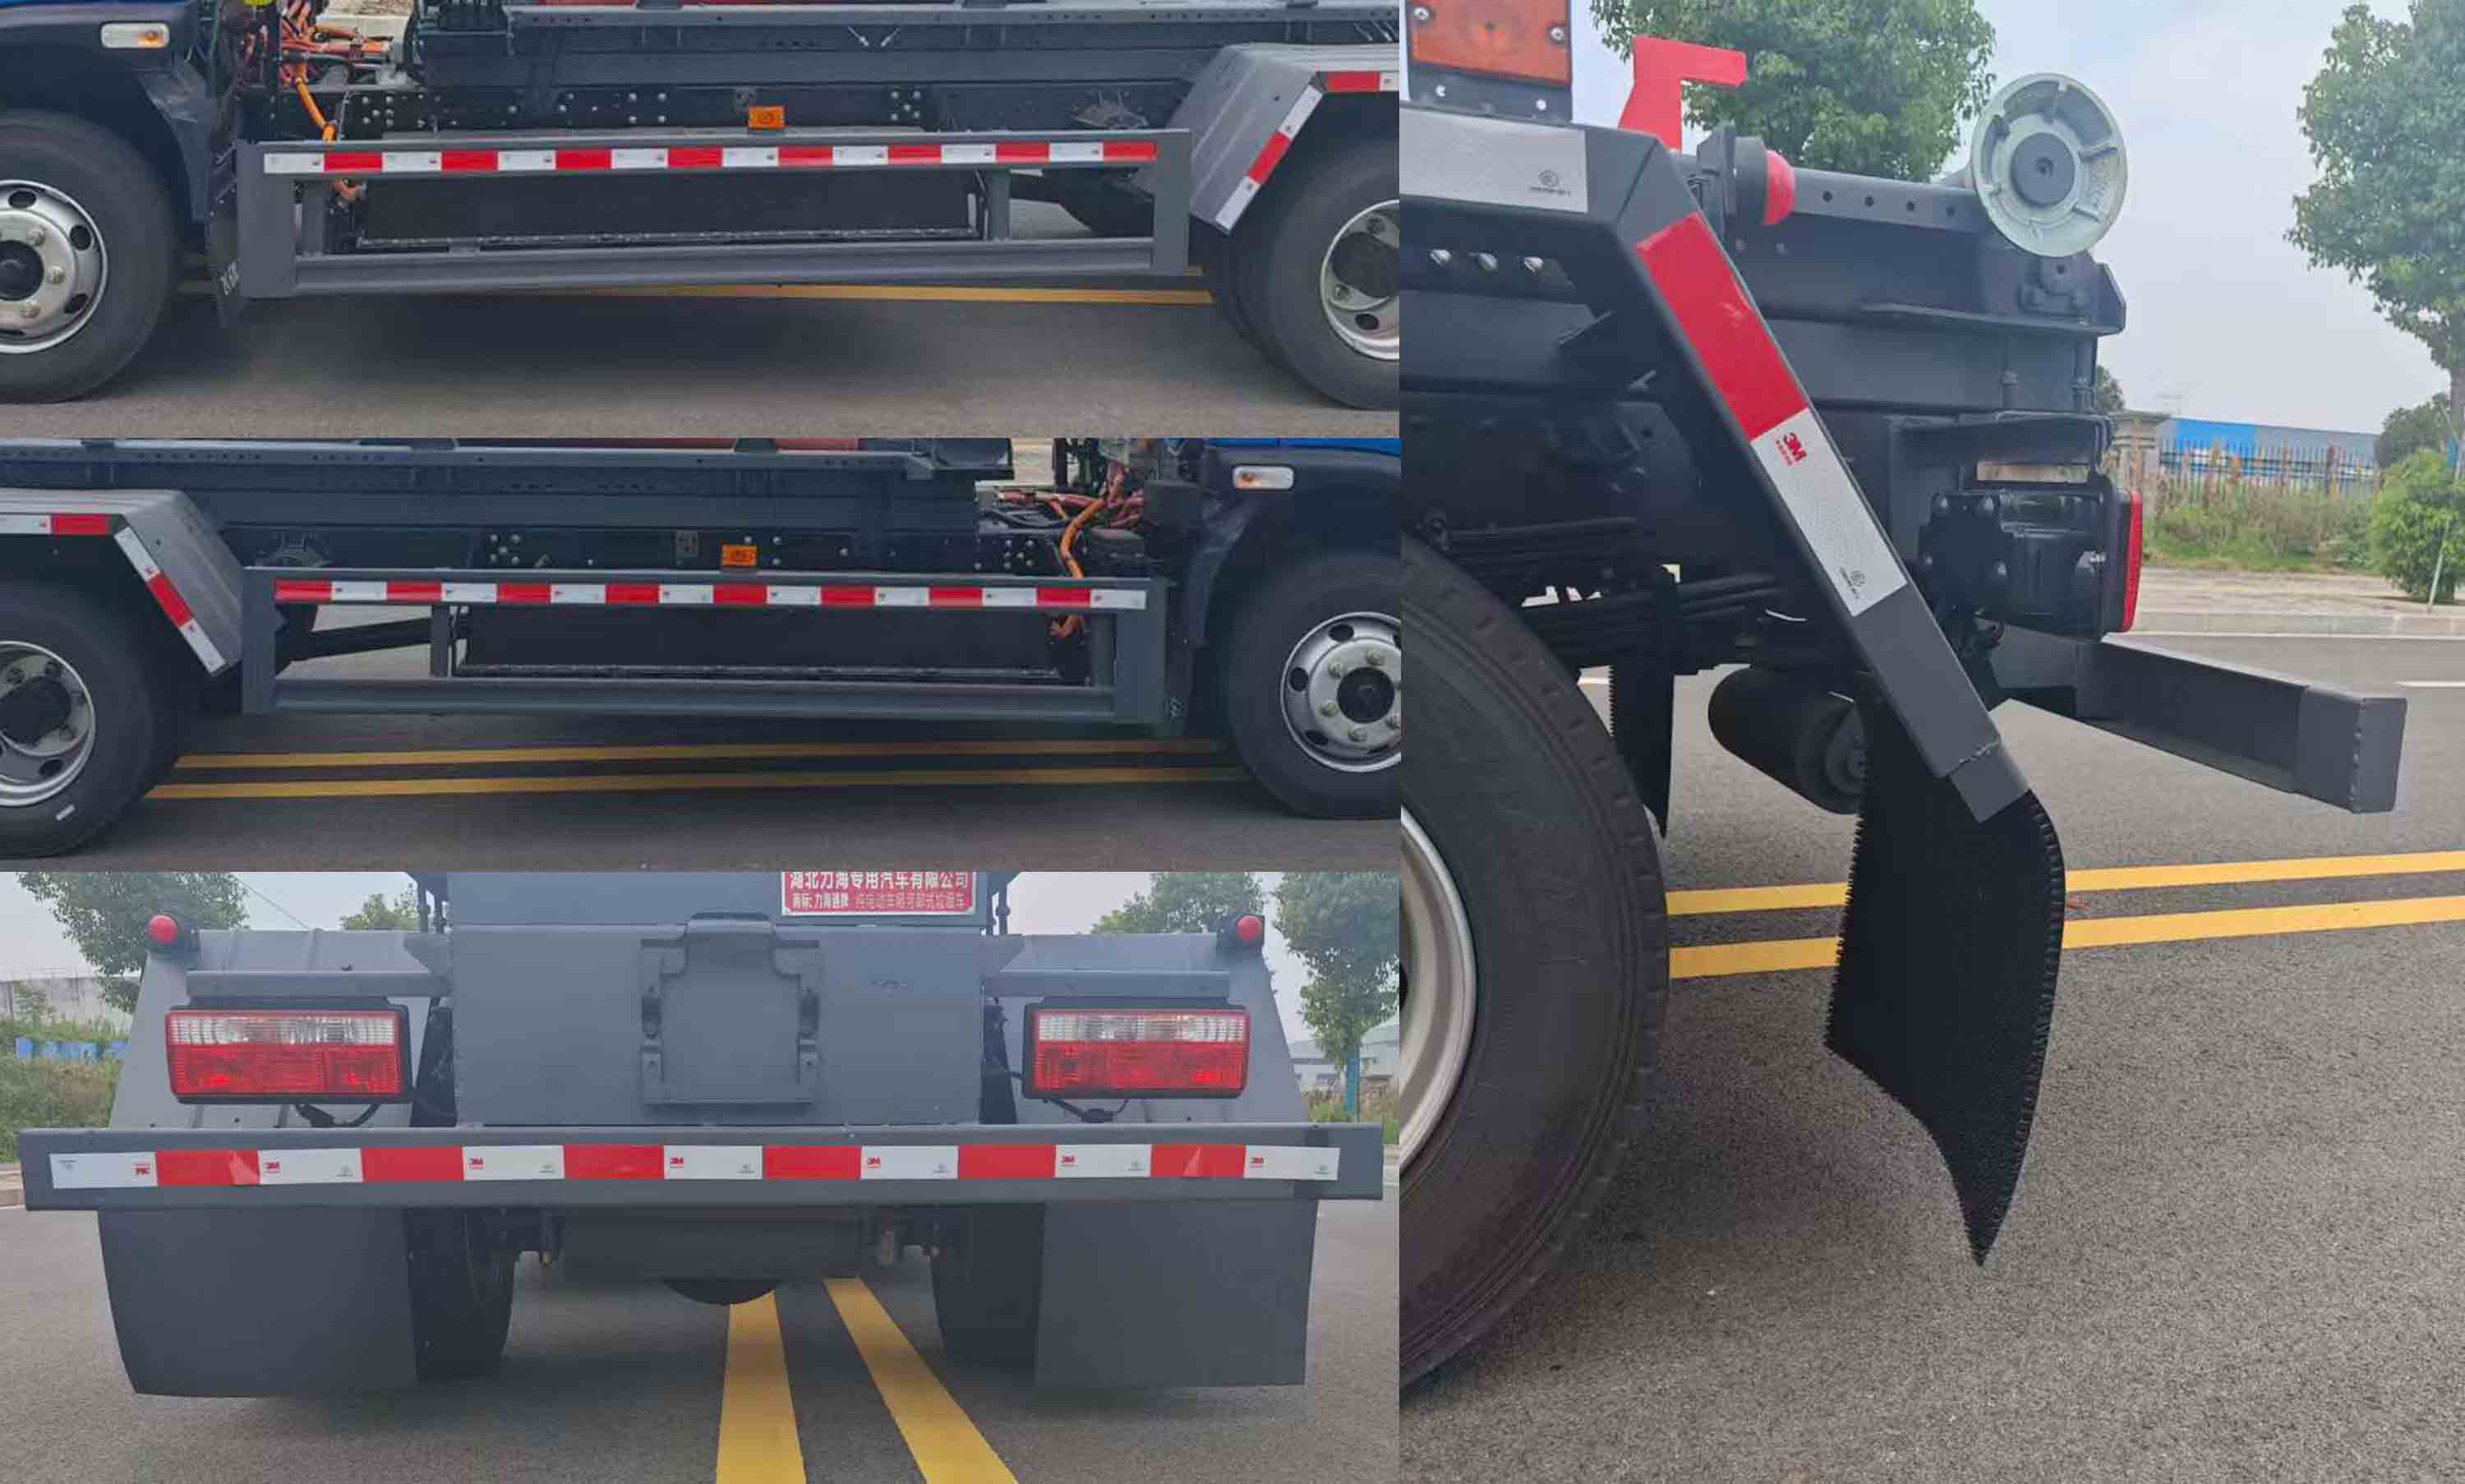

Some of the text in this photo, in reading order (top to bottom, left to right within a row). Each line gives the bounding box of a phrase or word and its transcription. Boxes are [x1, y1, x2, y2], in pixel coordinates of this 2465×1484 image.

[1783, 432, 1807, 462] 3M
[790, 872, 968, 889] 湖北力海专用汽车有限公司
[468, 1157, 484, 1166] 3M
[670, 1156, 684, 1165] 3M
[866, 1157, 881, 1165] 3M
[1061, 1155, 1076, 1164] 3M
[1250, 1156, 1265, 1164] 3M
[265, 1161, 281, 1170] 3M
